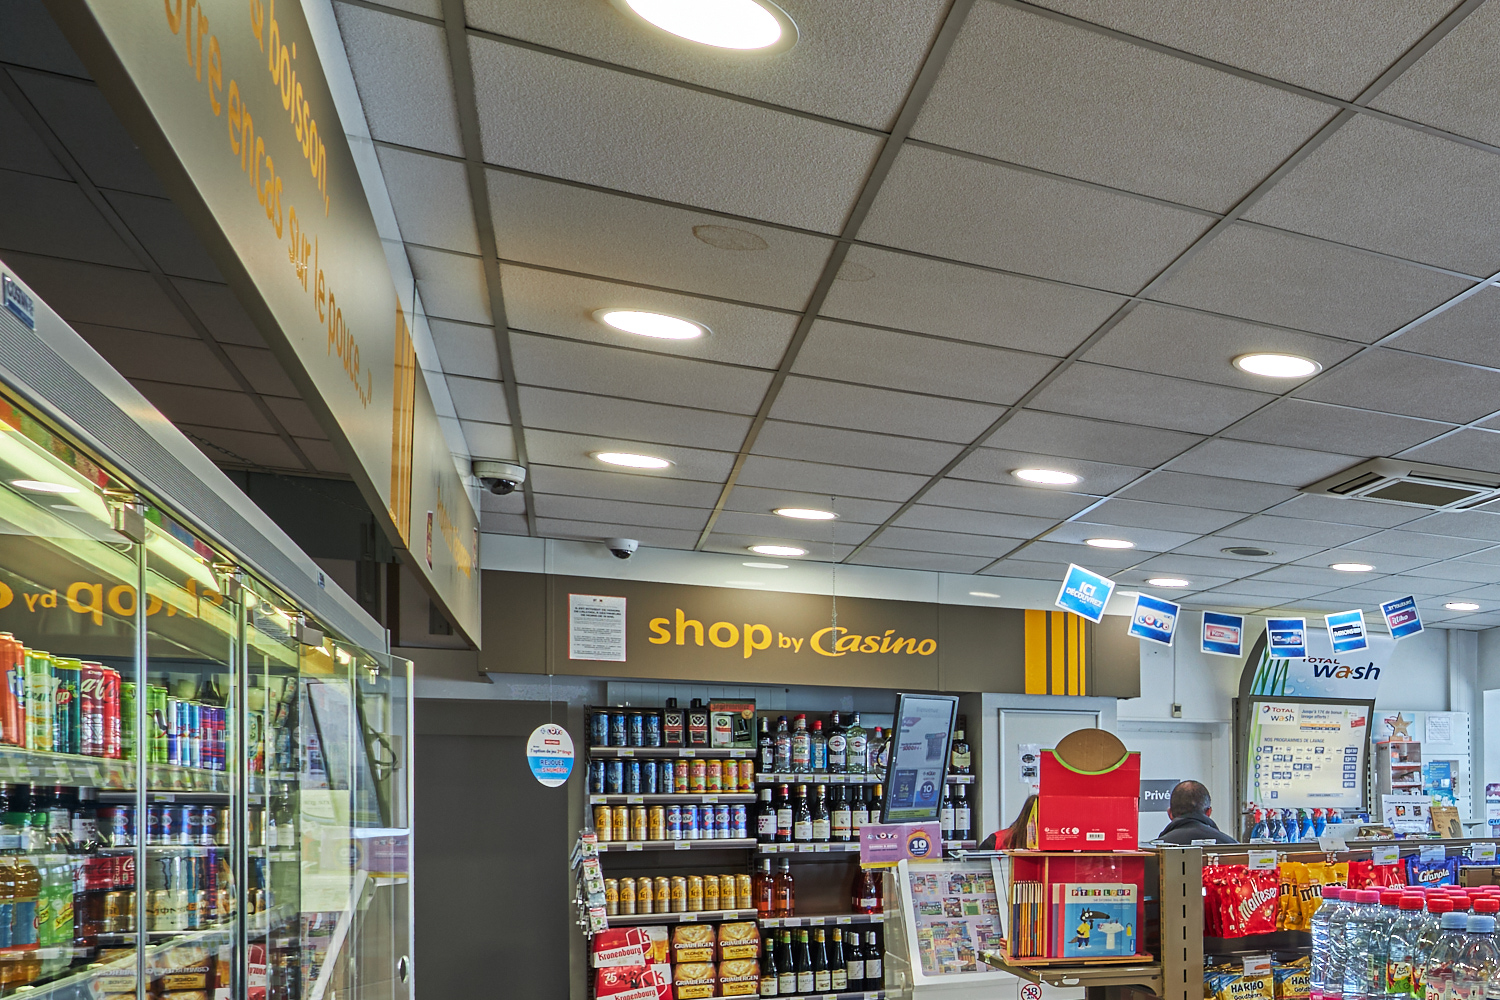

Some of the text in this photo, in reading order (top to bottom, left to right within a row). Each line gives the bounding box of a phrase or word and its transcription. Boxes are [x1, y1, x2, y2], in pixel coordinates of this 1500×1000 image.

[269, 0, 329, 217] boisson,
[228, 79, 283, 239] encas
[288, 205, 311, 293] sur
[314, 234, 325, 324] le
[1079, 582, 1097, 596] ICI
[1066, 587, 1103, 608] DÉCOUVREZ
[1138, 614, 1169, 630] LOTO
[648, 608, 772, 658] shop
[778, 633, 803, 653] by
[810, 627, 937, 657] Casino
[1314, 662, 1380, 680] wash
[1271, 714, 1295, 722] wash
[1144, 790, 1171, 801] Privé
[912, 840, 927, 849] 10
[1419, 869, 1449, 883] Granola
[1103, 888, 1131, 897] LOUP
[598, 946, 642, 961] Kronenbourg
[1231, 981, 1264, 993] HARIBO
[1234, 992, 1262, 1000] Goldbears
